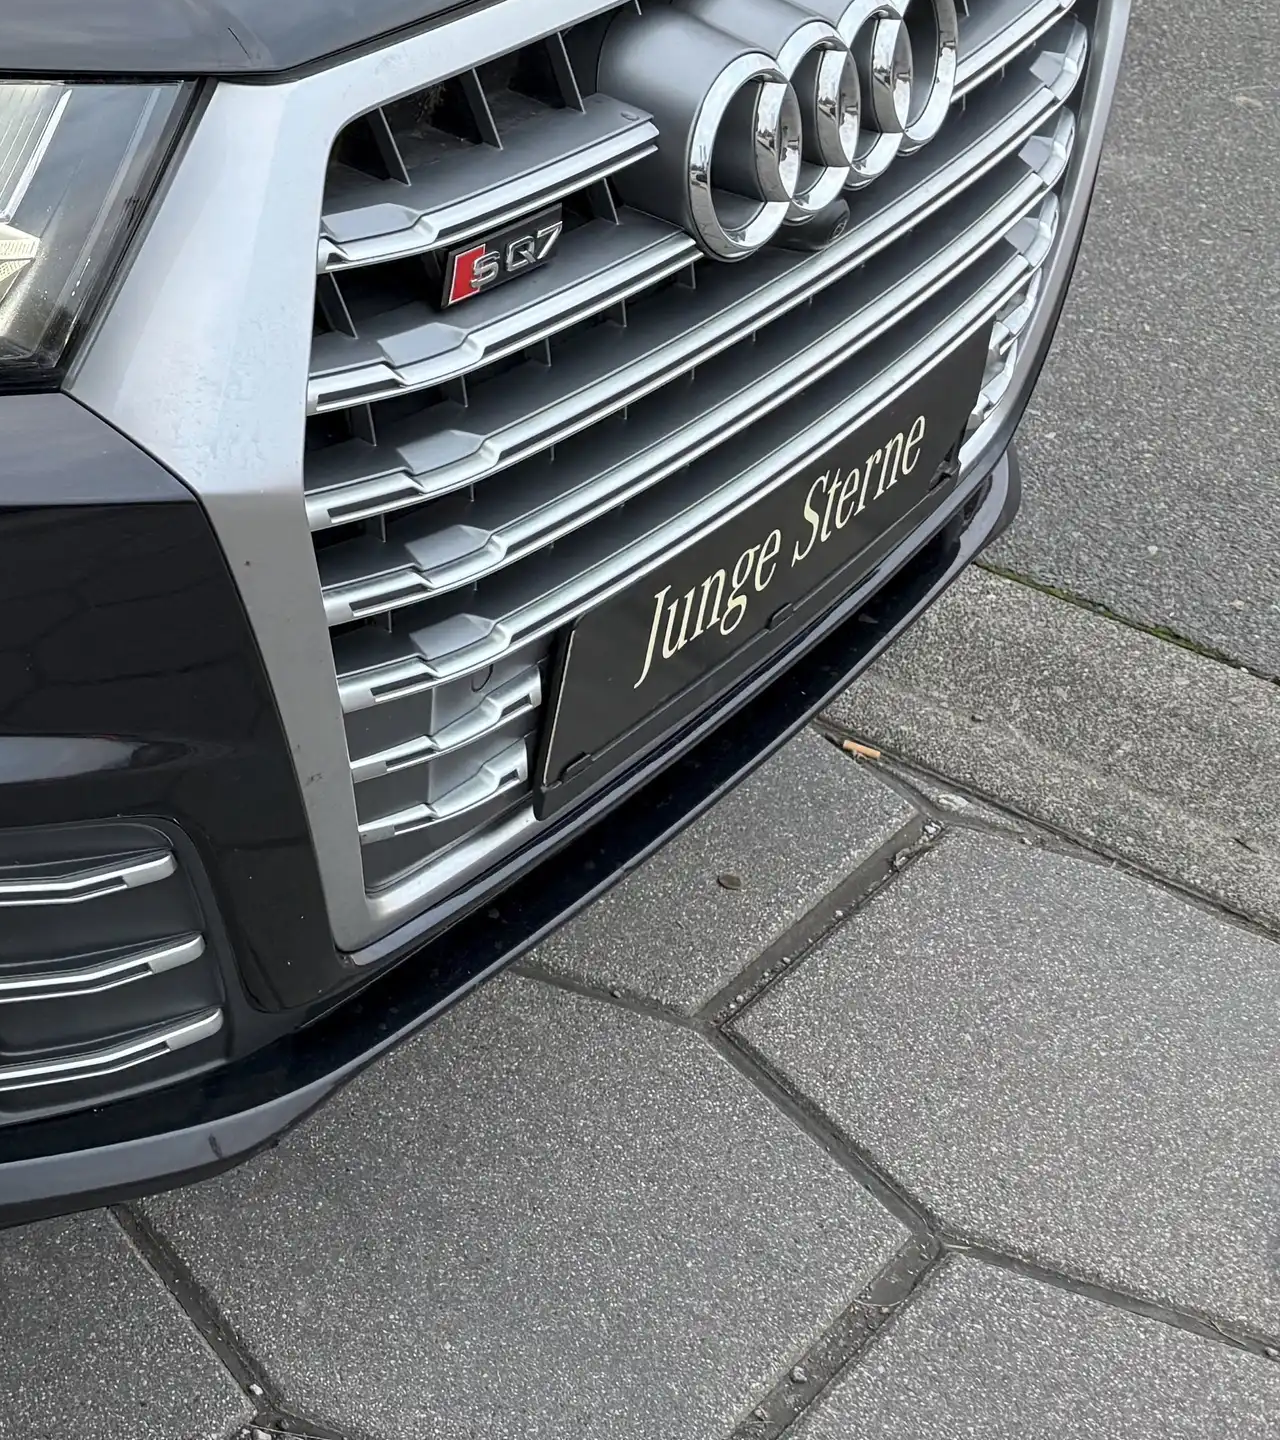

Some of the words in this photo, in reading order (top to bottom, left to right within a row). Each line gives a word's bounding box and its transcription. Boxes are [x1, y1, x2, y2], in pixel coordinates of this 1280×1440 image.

[470, 220, 564, 289] SQ7
[633, 527, 781, 690] Junge
[791, 414, 927, 568] Sterne
